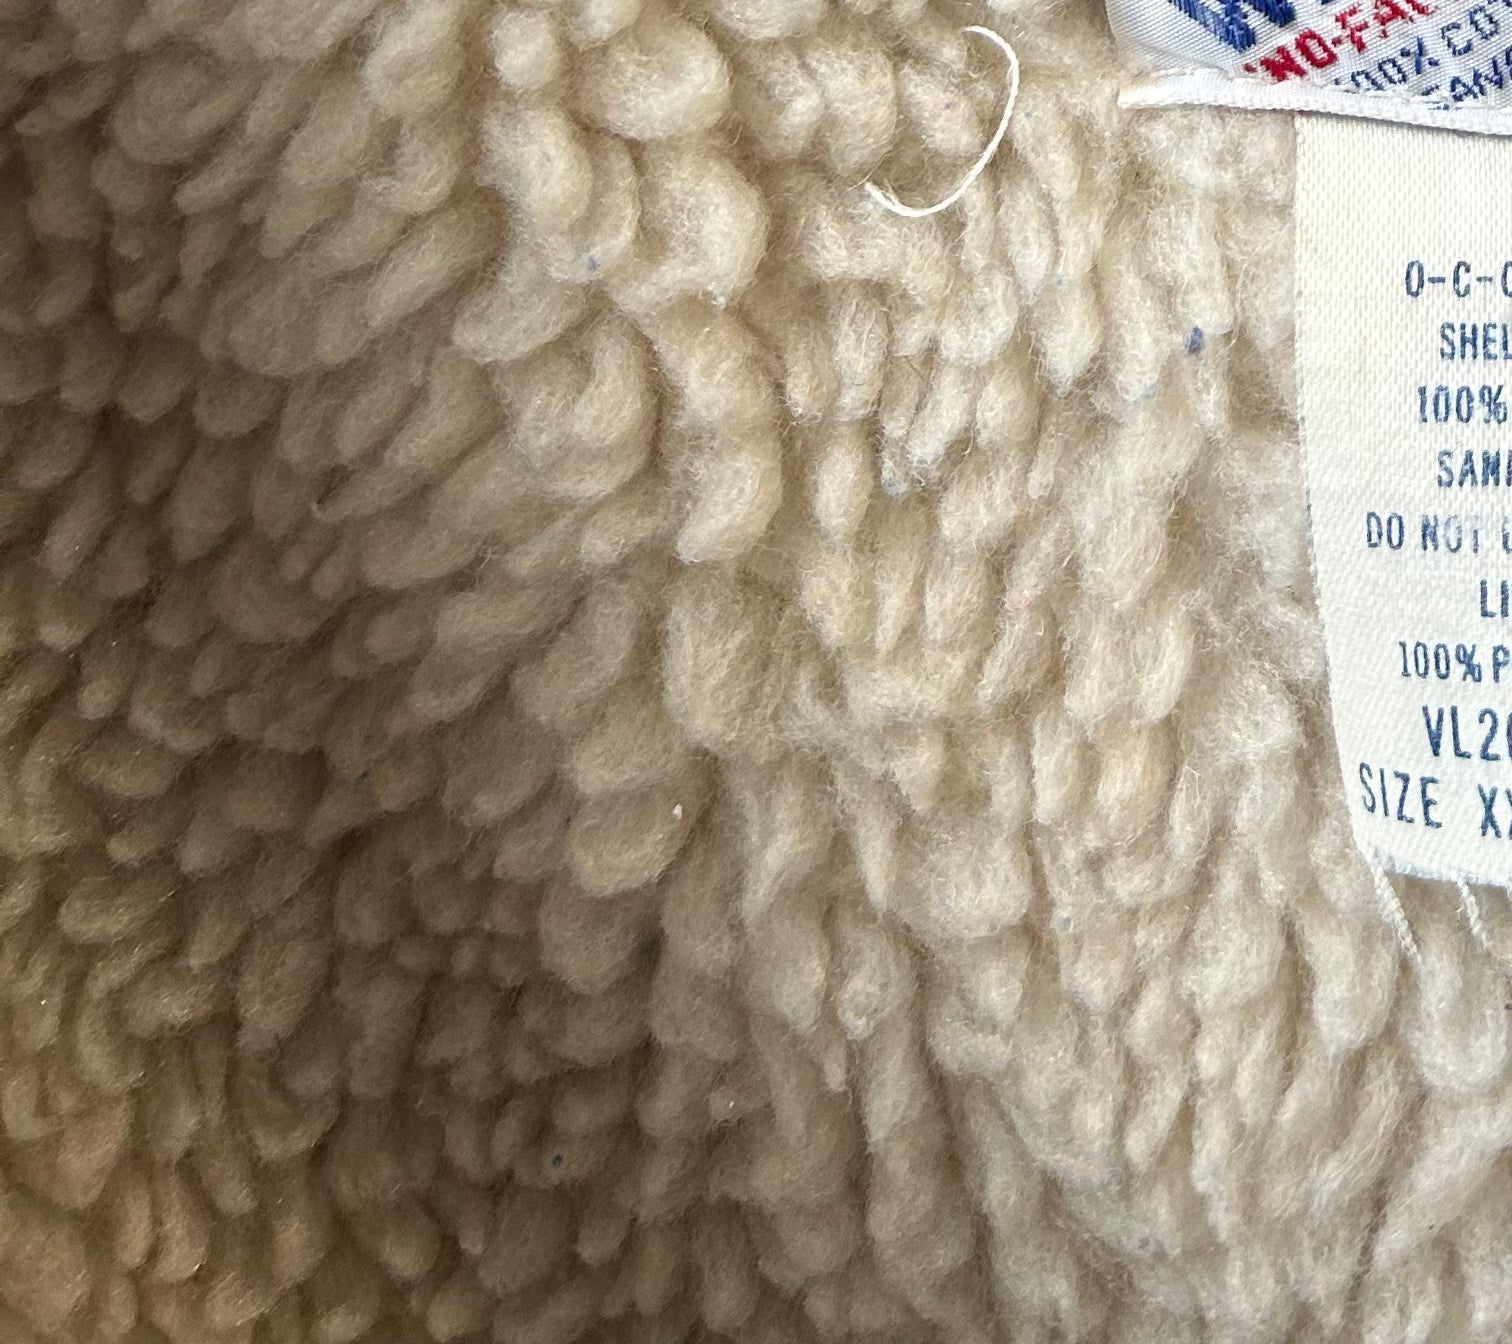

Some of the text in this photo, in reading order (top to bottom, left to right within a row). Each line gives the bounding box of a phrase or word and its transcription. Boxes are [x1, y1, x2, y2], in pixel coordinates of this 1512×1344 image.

[1417, 384, 1509, 424] 100%
[1365, 511, 1405, 550] DO
[1420, 514, 1481, 553] NOT
[1398, 641, 1483, 682] 100%
[1358, 762, 1443, 829] SIZE
